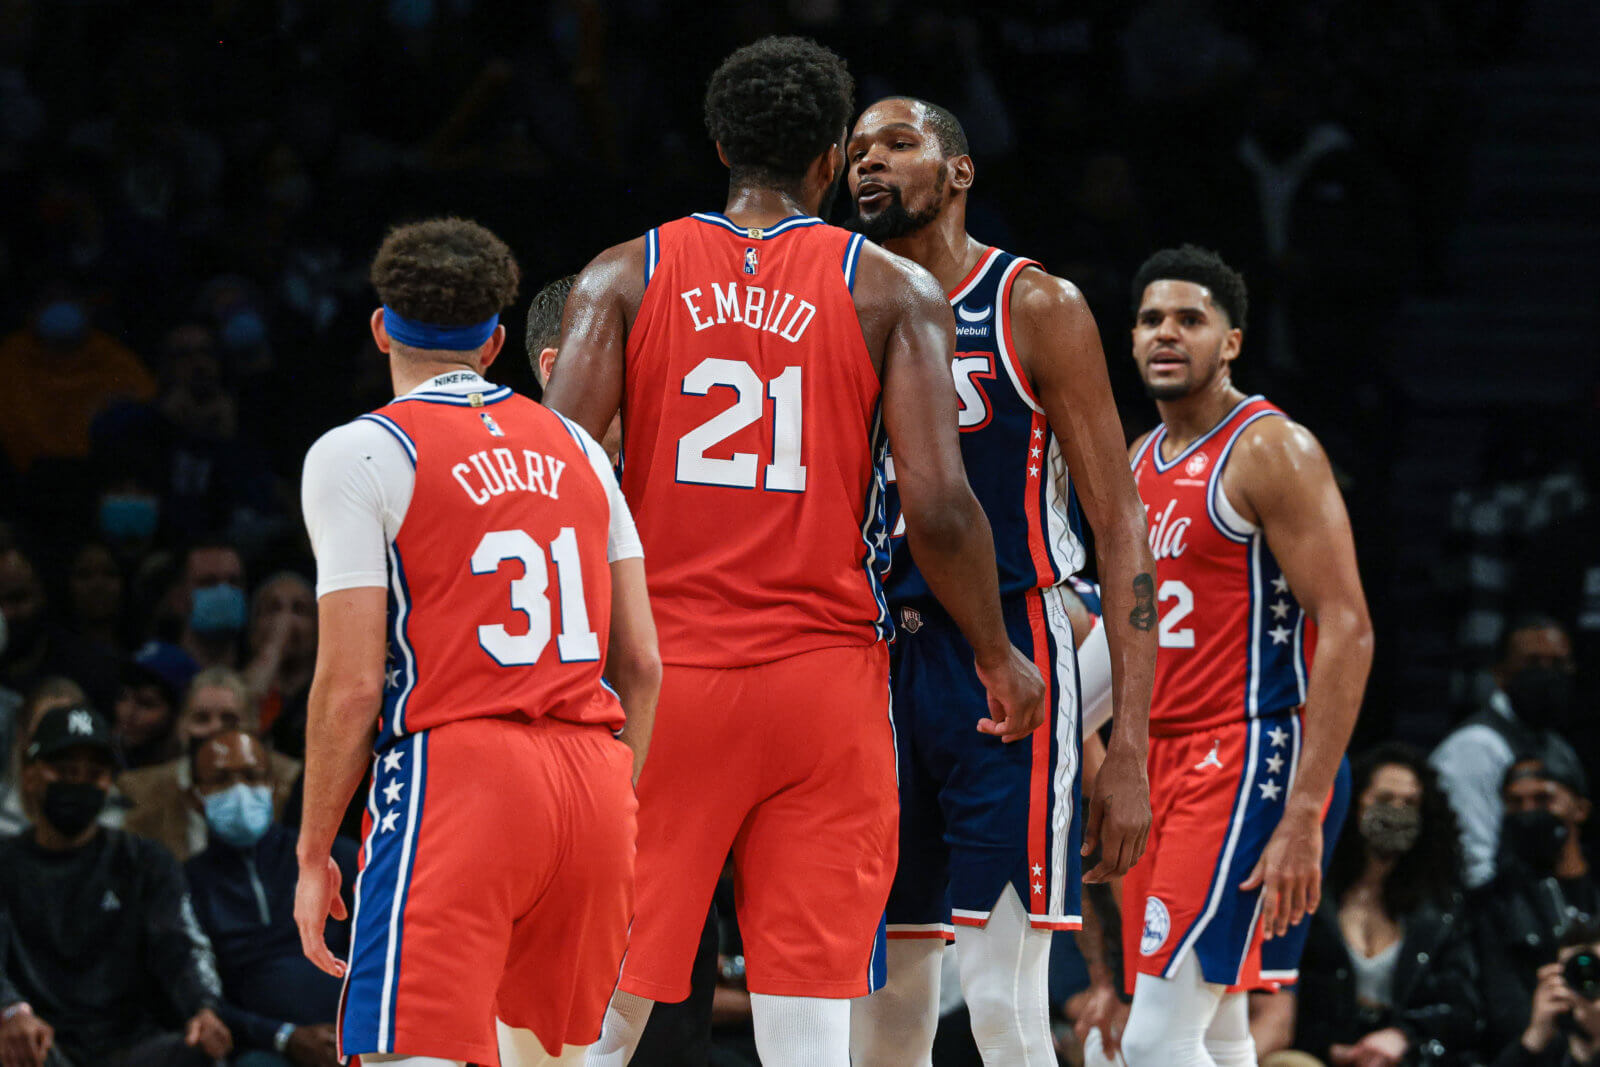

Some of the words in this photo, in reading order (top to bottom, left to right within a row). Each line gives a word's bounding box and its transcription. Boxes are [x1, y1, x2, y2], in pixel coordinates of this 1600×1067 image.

[681, 282, 816, 342] EMBIID
[955, 326, 987, 336] Webull
[434, 374, 459, 387] NIKE
[676, 358, 806, 492] 21
[452, 448, 565, 505] CURRY
[470, 527, 600, 667] 31
